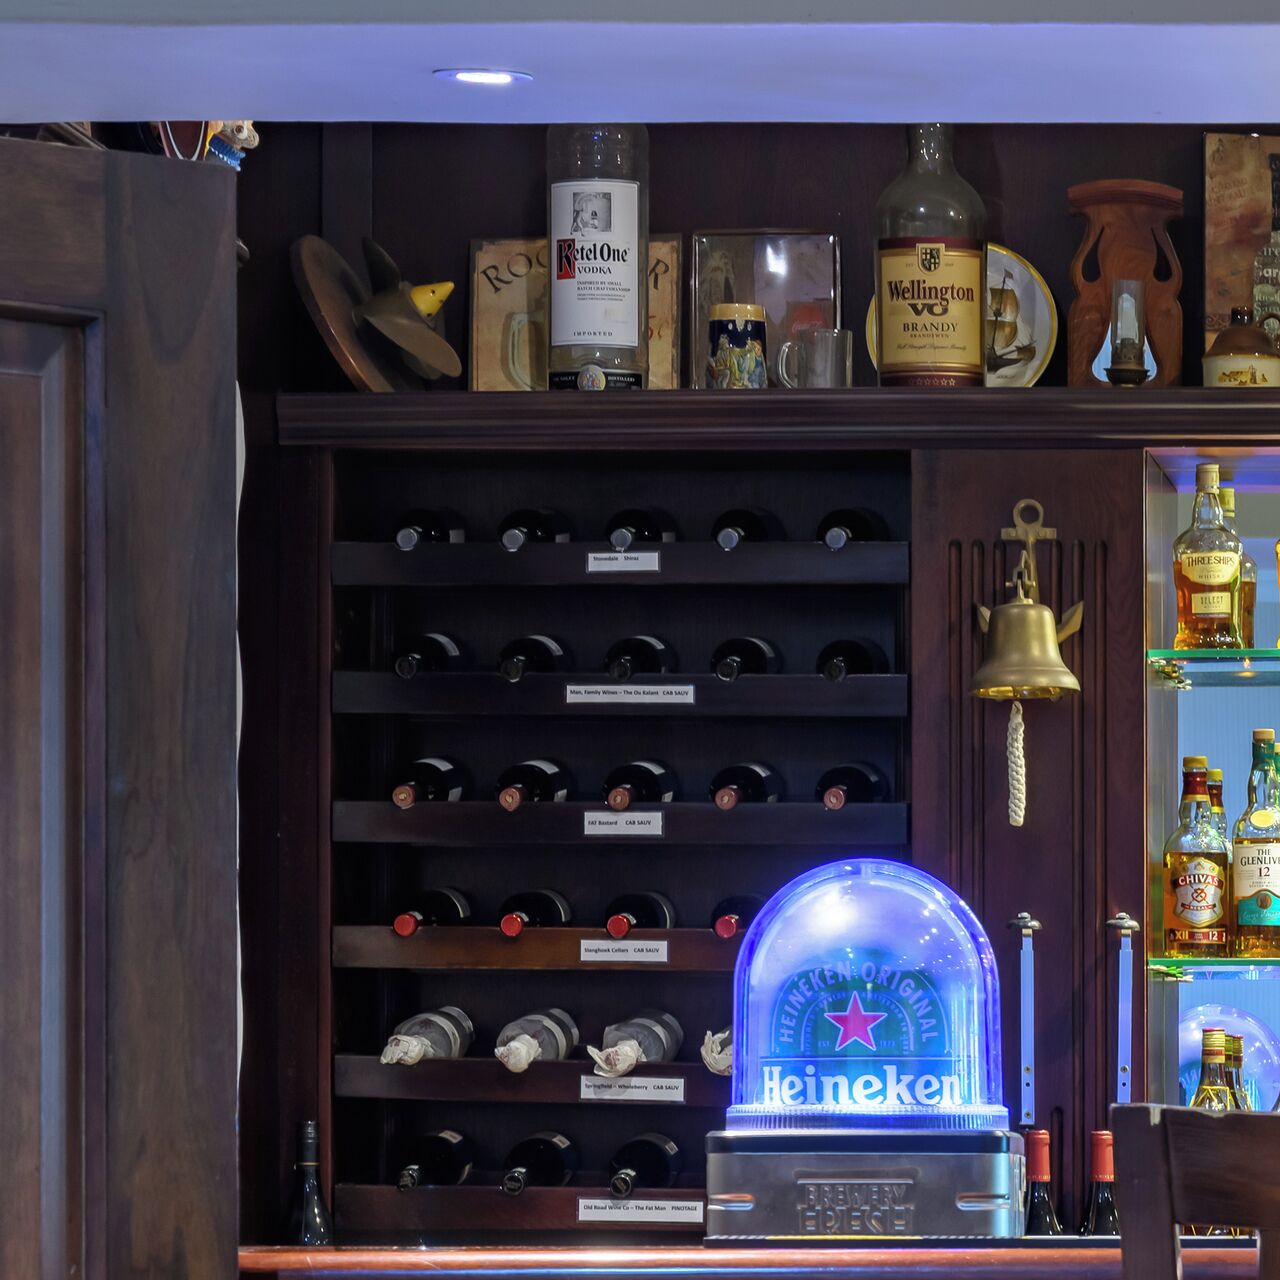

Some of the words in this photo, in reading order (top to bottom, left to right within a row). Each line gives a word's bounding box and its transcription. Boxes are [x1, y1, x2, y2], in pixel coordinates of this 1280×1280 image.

[557, 240, 597, 277] Ketel
[600, 243, 629, 263] One
[577, 266, 613, 275] VODKA
[887, 280, 975, 306] Wellington
[903, 322, 958, 334] BRANDY
[1186, 556, 1212, 567] THREE
[1213, 555, 1235, 566] SHIPS
[1200, 596, 1223, 605] SELECT
[1258, 867, 1271, 877] 12
[1178, 874, 1219, 886] CHIVAS
[1209, 932, 1218, 941] 12
[780, 961, 852, 1044] HEINEKEN
[861, 961, 940, 1043] ORIGINAL
[618, 1083, 648, 1092] Wholeberry
[763, 1064, 963, 1105] Heineken
